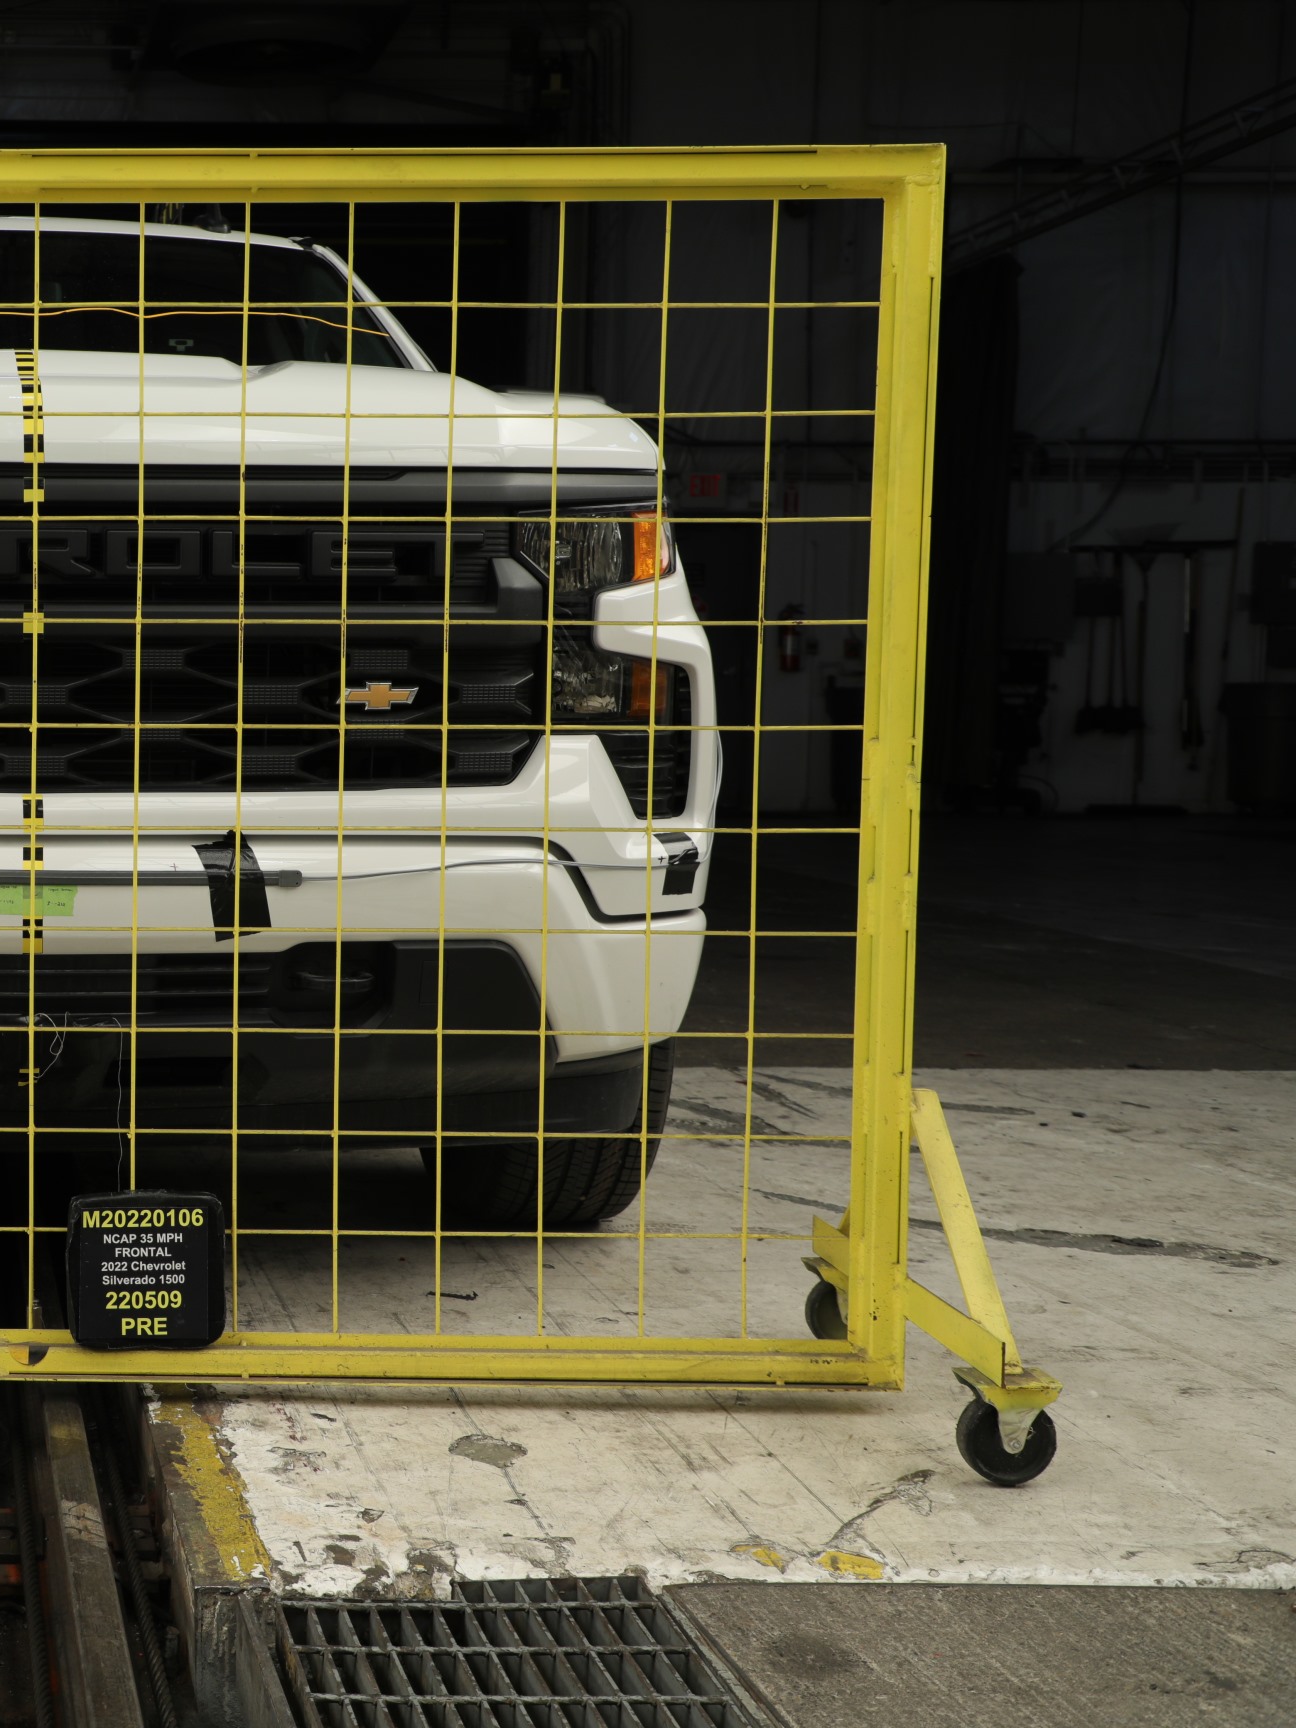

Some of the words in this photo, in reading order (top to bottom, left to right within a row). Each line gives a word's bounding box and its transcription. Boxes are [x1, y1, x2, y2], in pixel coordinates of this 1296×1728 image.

[689, 475, 720, 497] EXIT
[82, 1209, 203, 1228] M20220106
[103, 1234, 136, 1243] NCAP
[140, 1234, 153, 1243] 35
[156, 1233, 182, 1243] MPH
[114, 1247, 171, 1257] FRONTAL
[101, 1262, 127, 1271] 2022
[130, 1261, 185, 1271] Chevrolet
[102, 1275, 155, 1285] Silverado
[159, 1274, 185, 1284] 1500
[105, 1290, 181, 1309] 220509
[121, 1318, 167, 1335] PRE
